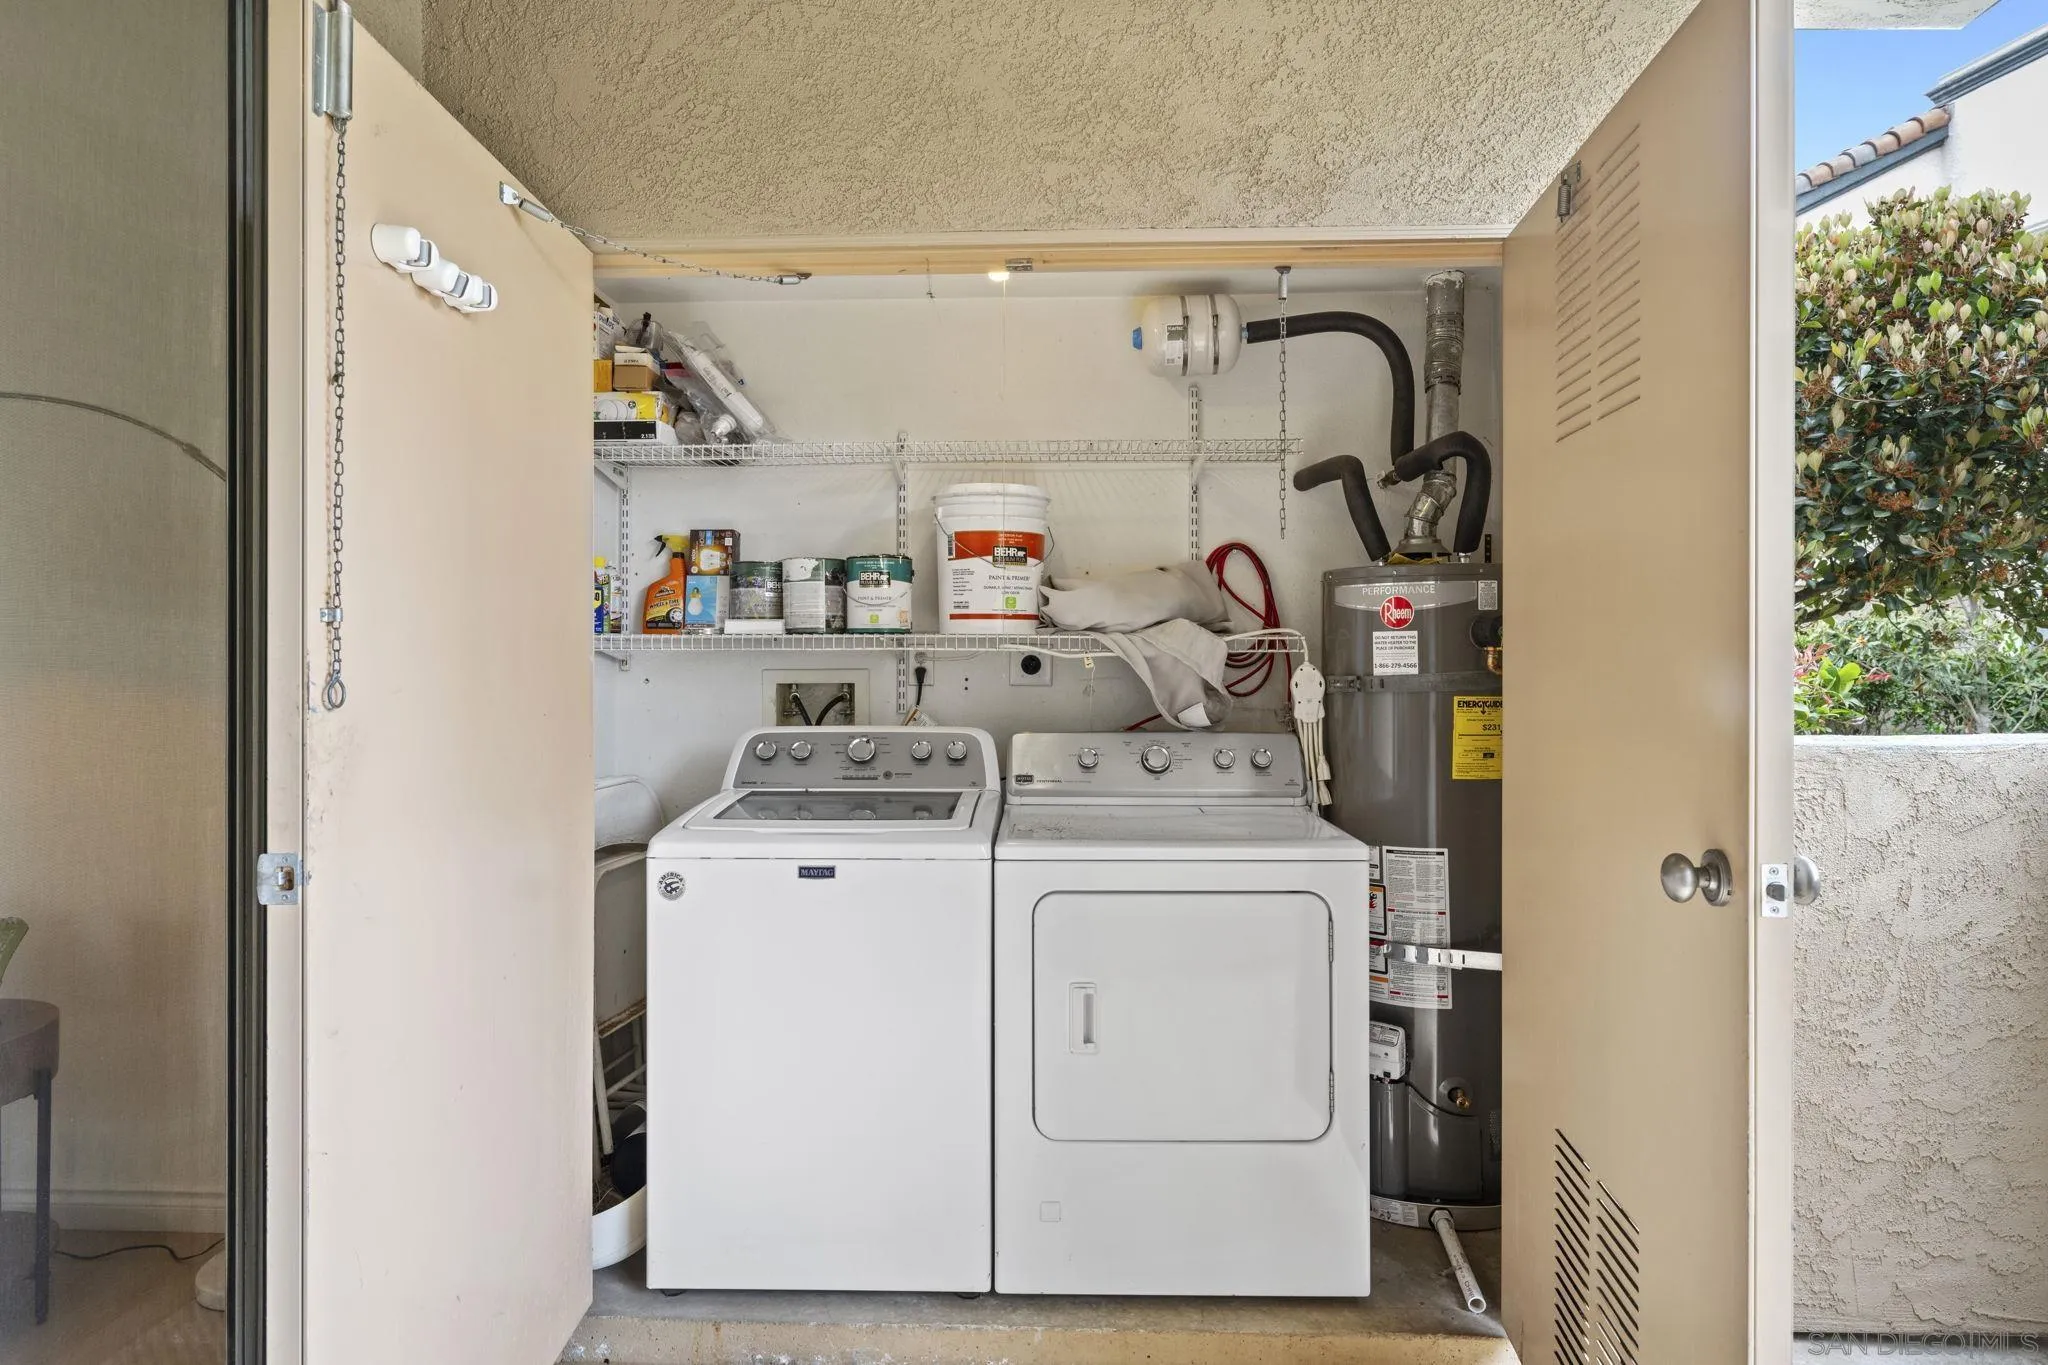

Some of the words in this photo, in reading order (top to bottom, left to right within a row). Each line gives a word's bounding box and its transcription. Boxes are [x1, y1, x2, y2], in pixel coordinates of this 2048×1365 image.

[994, 547, 1017, 557] BEHR
[860, 572, 880, 581] BEHR
[1362, 584, 1436, 596] PERFORMANCE
[1384, 597, 1412, 624] Rheem
[800, 868, 834, 876] MAYTAG
